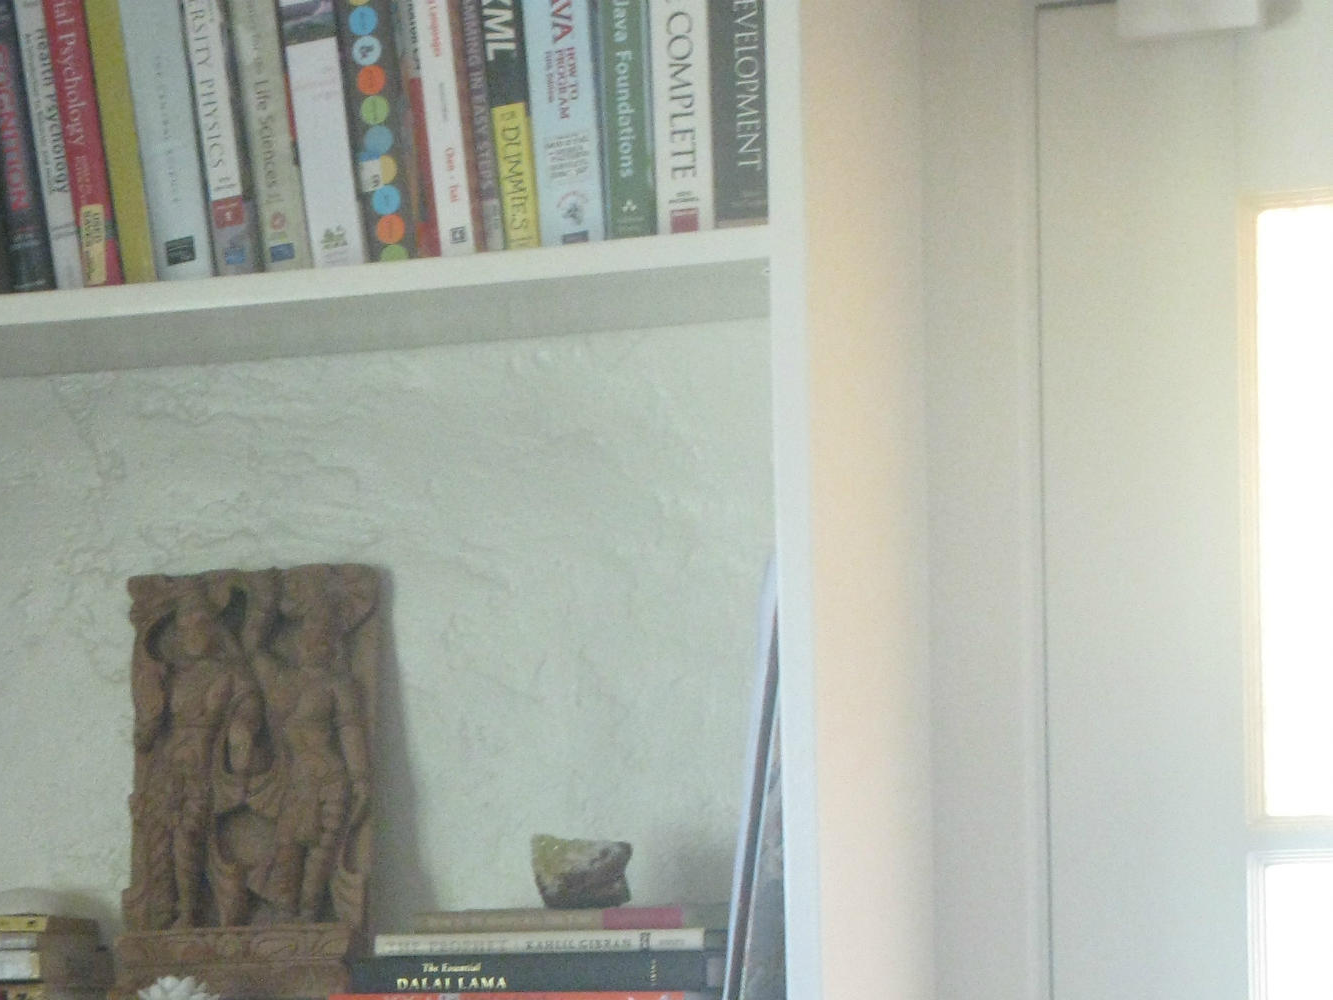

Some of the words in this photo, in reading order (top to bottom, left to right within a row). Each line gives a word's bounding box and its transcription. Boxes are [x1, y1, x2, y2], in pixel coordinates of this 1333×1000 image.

[36, 28, 57, 88] Health
[56, 33, 89, 147] Psychology
[470, 73, 484, 90] IN
[555, 50, 571, 119] PROGRAM
[565, 47, 577, 79] HOW
[197, 79, 227, 169] PHYSICS
[254, 80, 271, 112] Life
[473, 96, 489, 136] EASY
[614, 50, 636, 178] Foundations
[665, 11, 698, 181] COMPLETE
[42, 92, 71, 194] Psychology
[260, 114, 277, 191] Sciences
[478, 141, 494, 190] STEPS
[497, 126, 529, 232] DUMMIES
[396, 976, 453, 990] DALAI
[457, 976, 508, 991] LAMA
[422, 963, 440, 974] The
